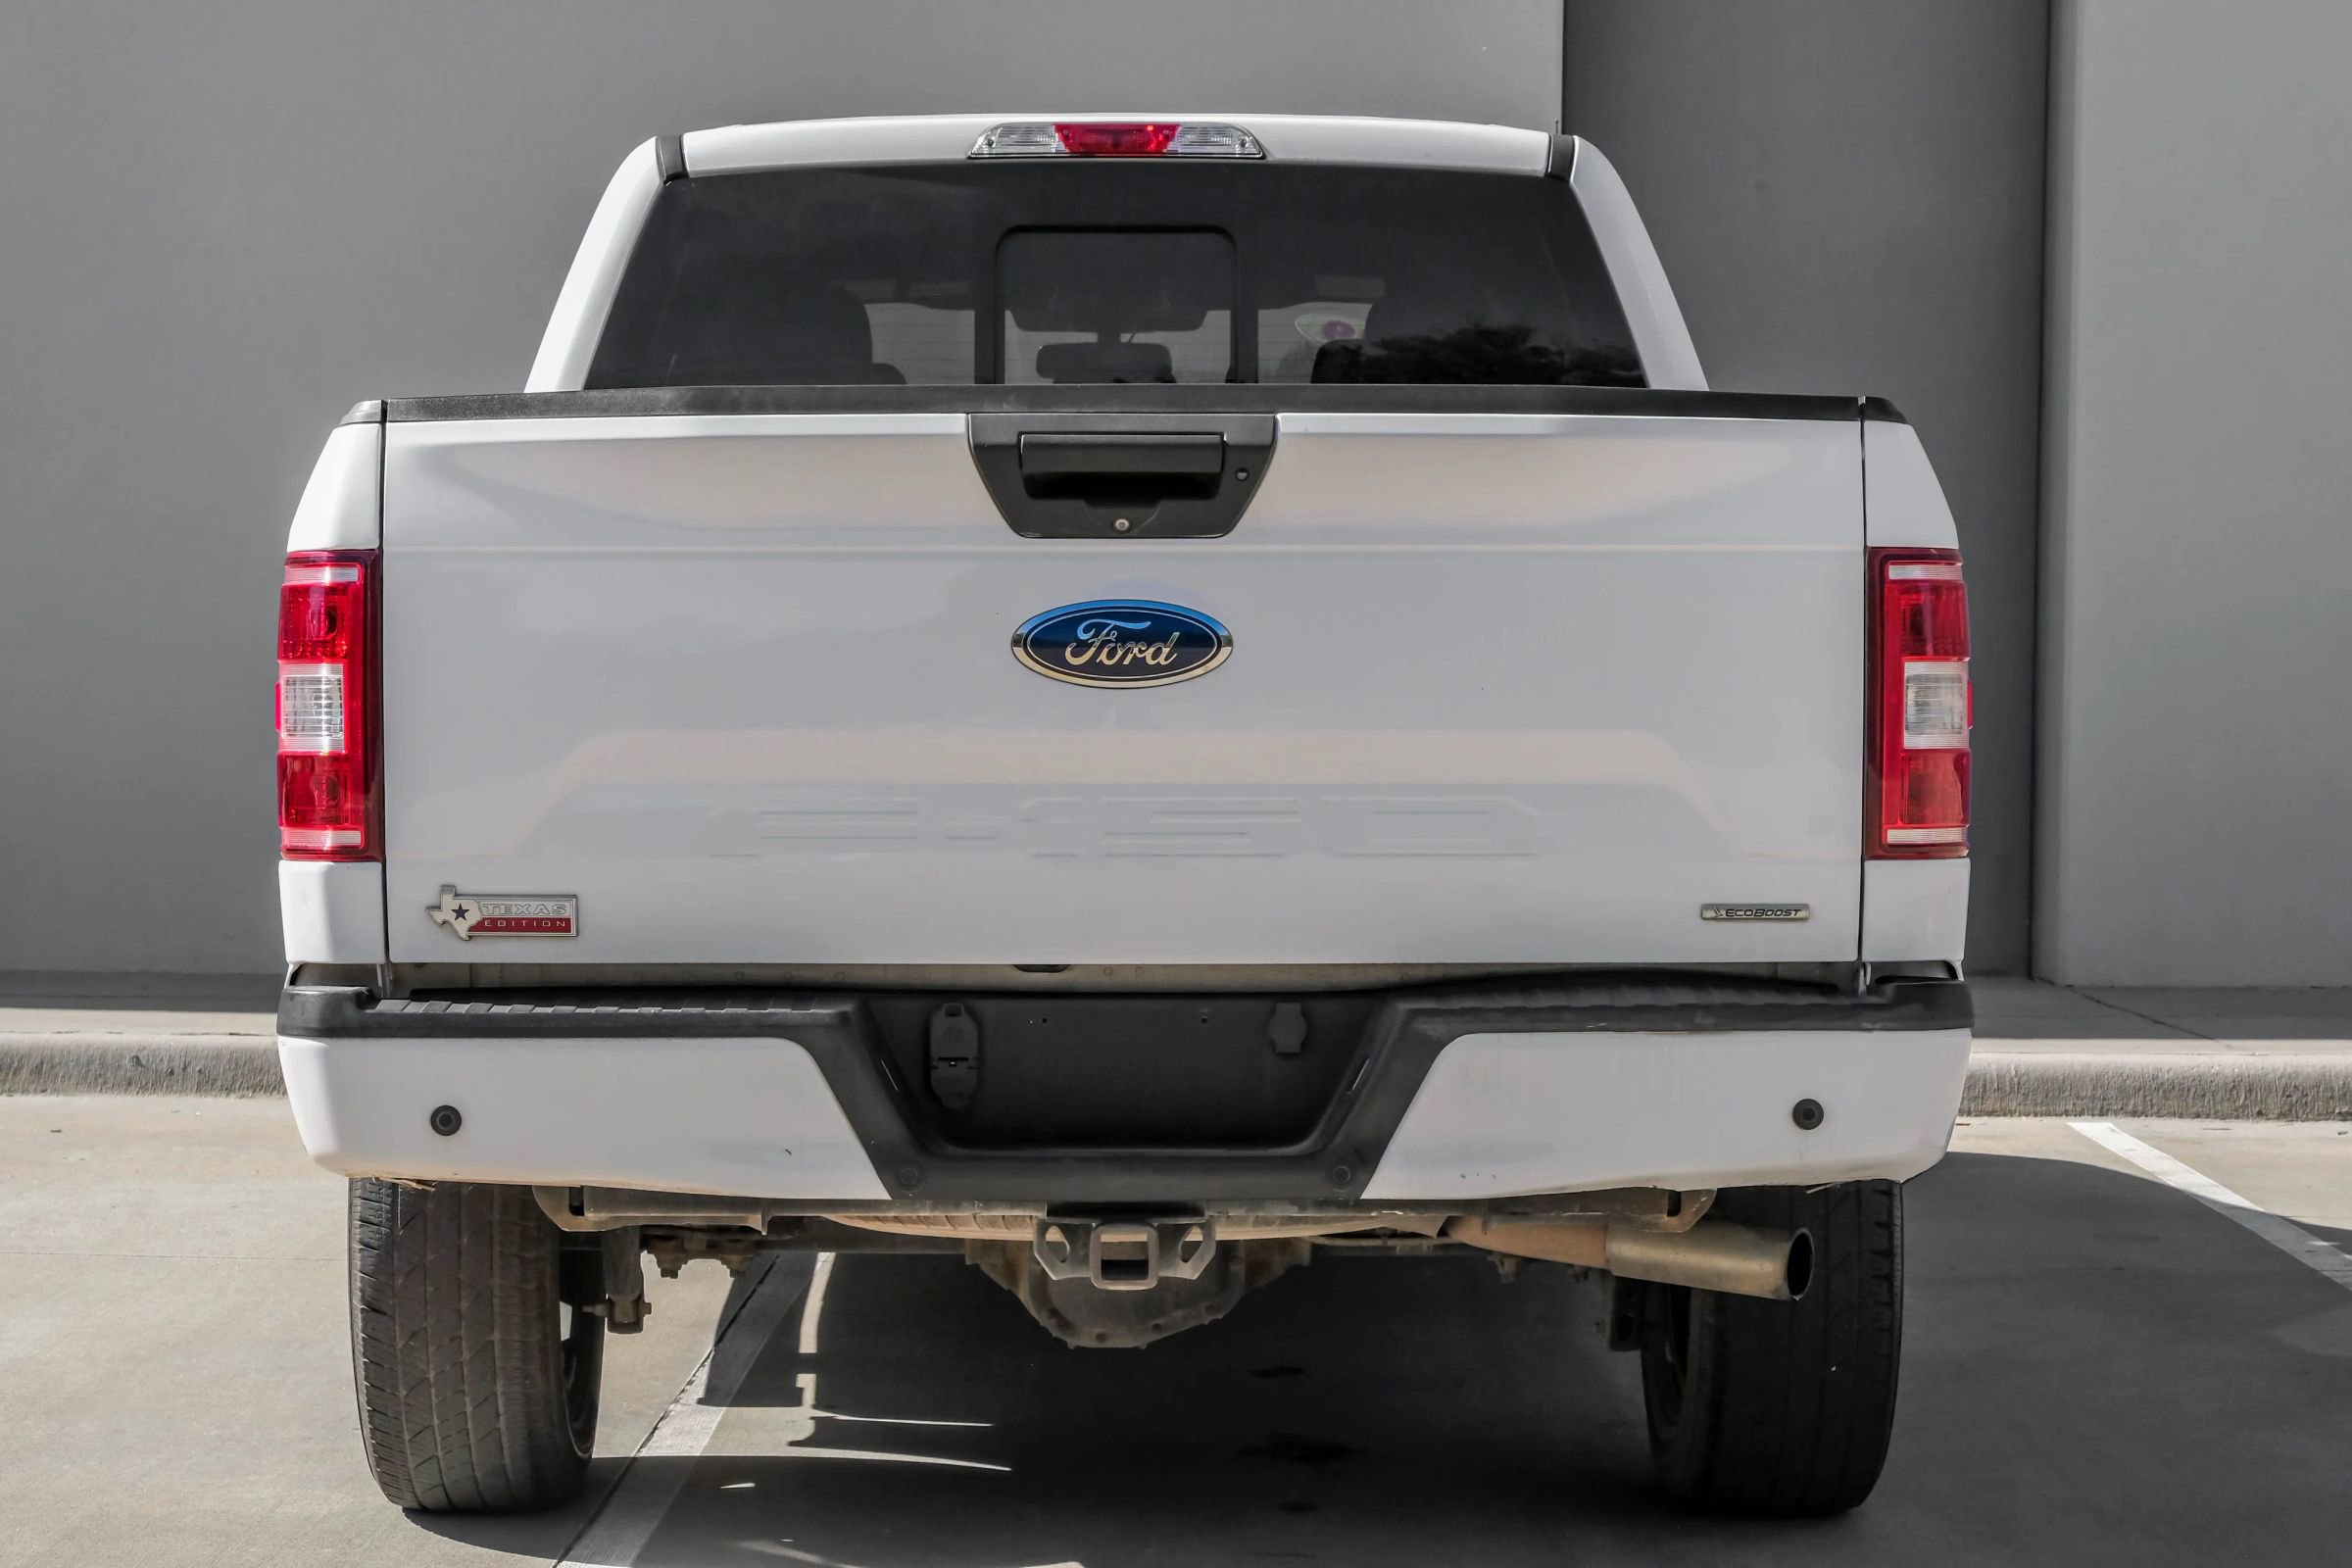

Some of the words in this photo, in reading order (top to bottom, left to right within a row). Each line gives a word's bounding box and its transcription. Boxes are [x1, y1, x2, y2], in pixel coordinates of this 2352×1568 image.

[1064, 618, 1180, 665] Ford
[482, 903, 567, 915] TEXAS
[1725, 908, 1802, 917] ECOBOOST
